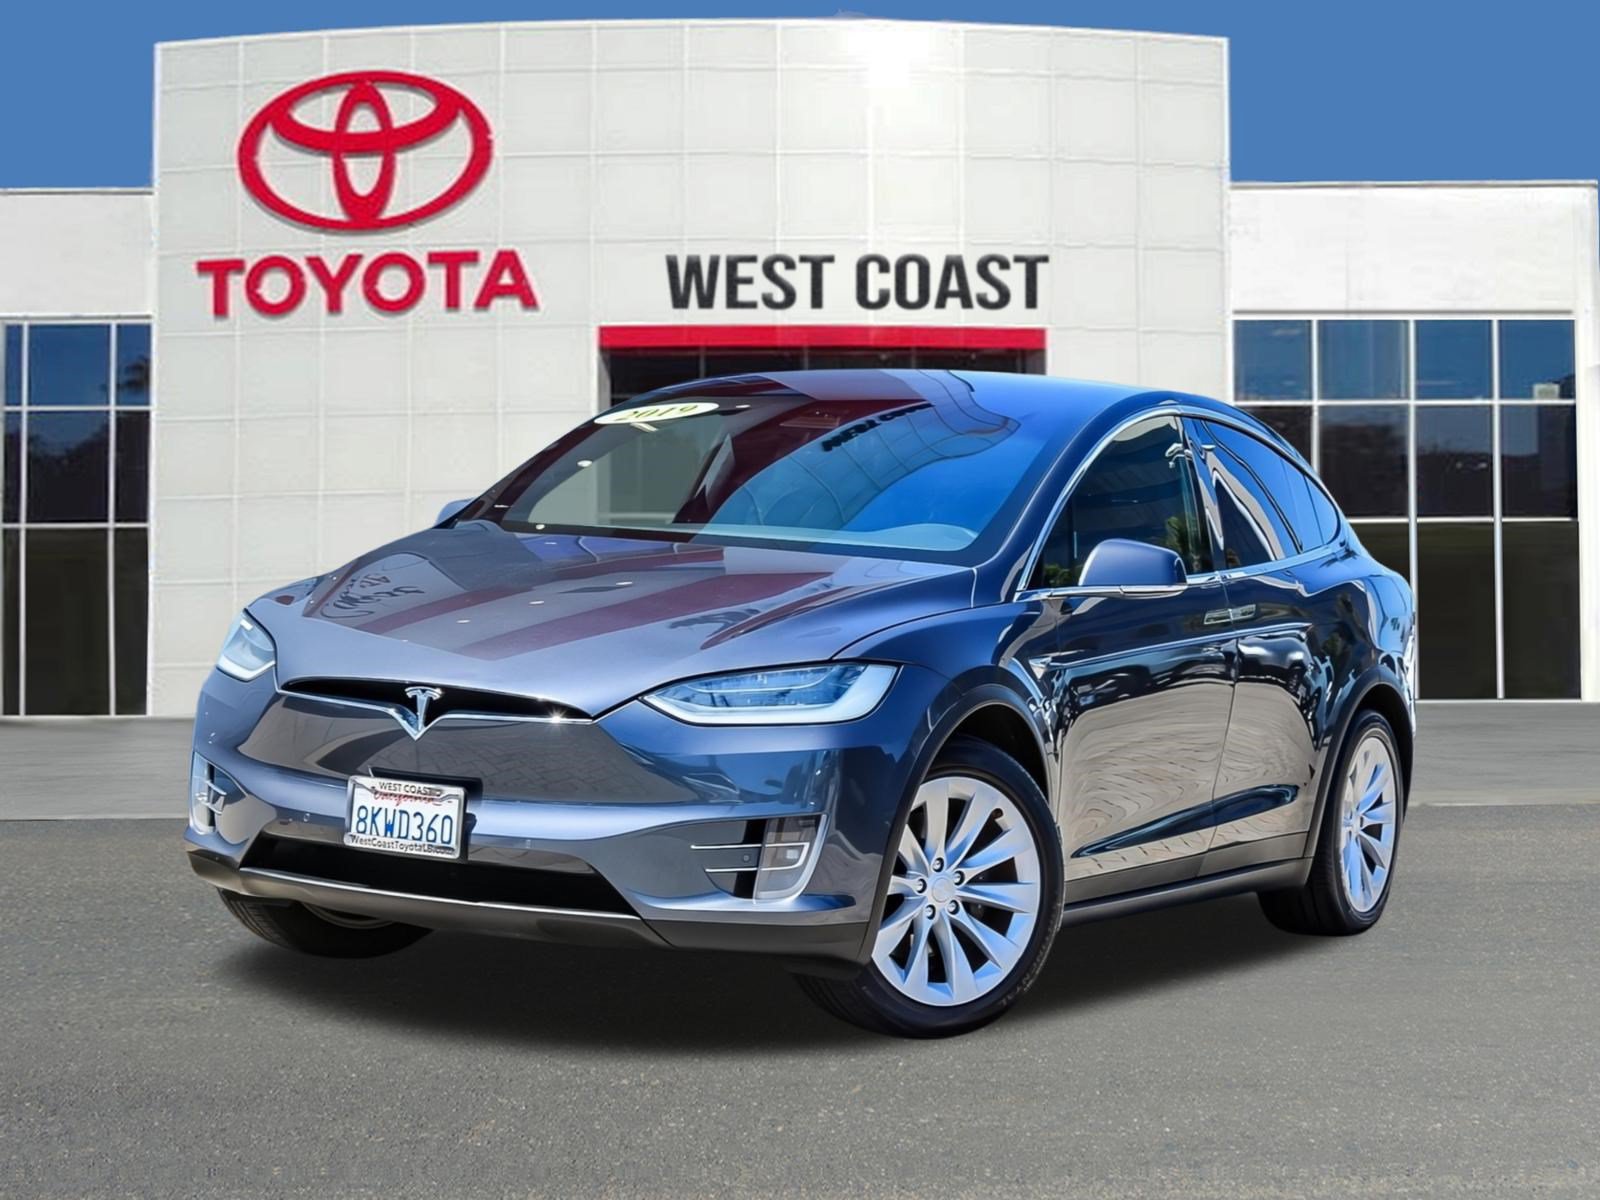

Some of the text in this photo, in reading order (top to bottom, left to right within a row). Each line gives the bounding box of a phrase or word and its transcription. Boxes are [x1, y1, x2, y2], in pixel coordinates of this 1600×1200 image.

[195, 249, 539, 317] TOYOTA
[665, 254, 1050, 310] WEST COAST
[379, 782, 433, 796] WEST COAST
[356, 805, 453, 845] 8KWD360
